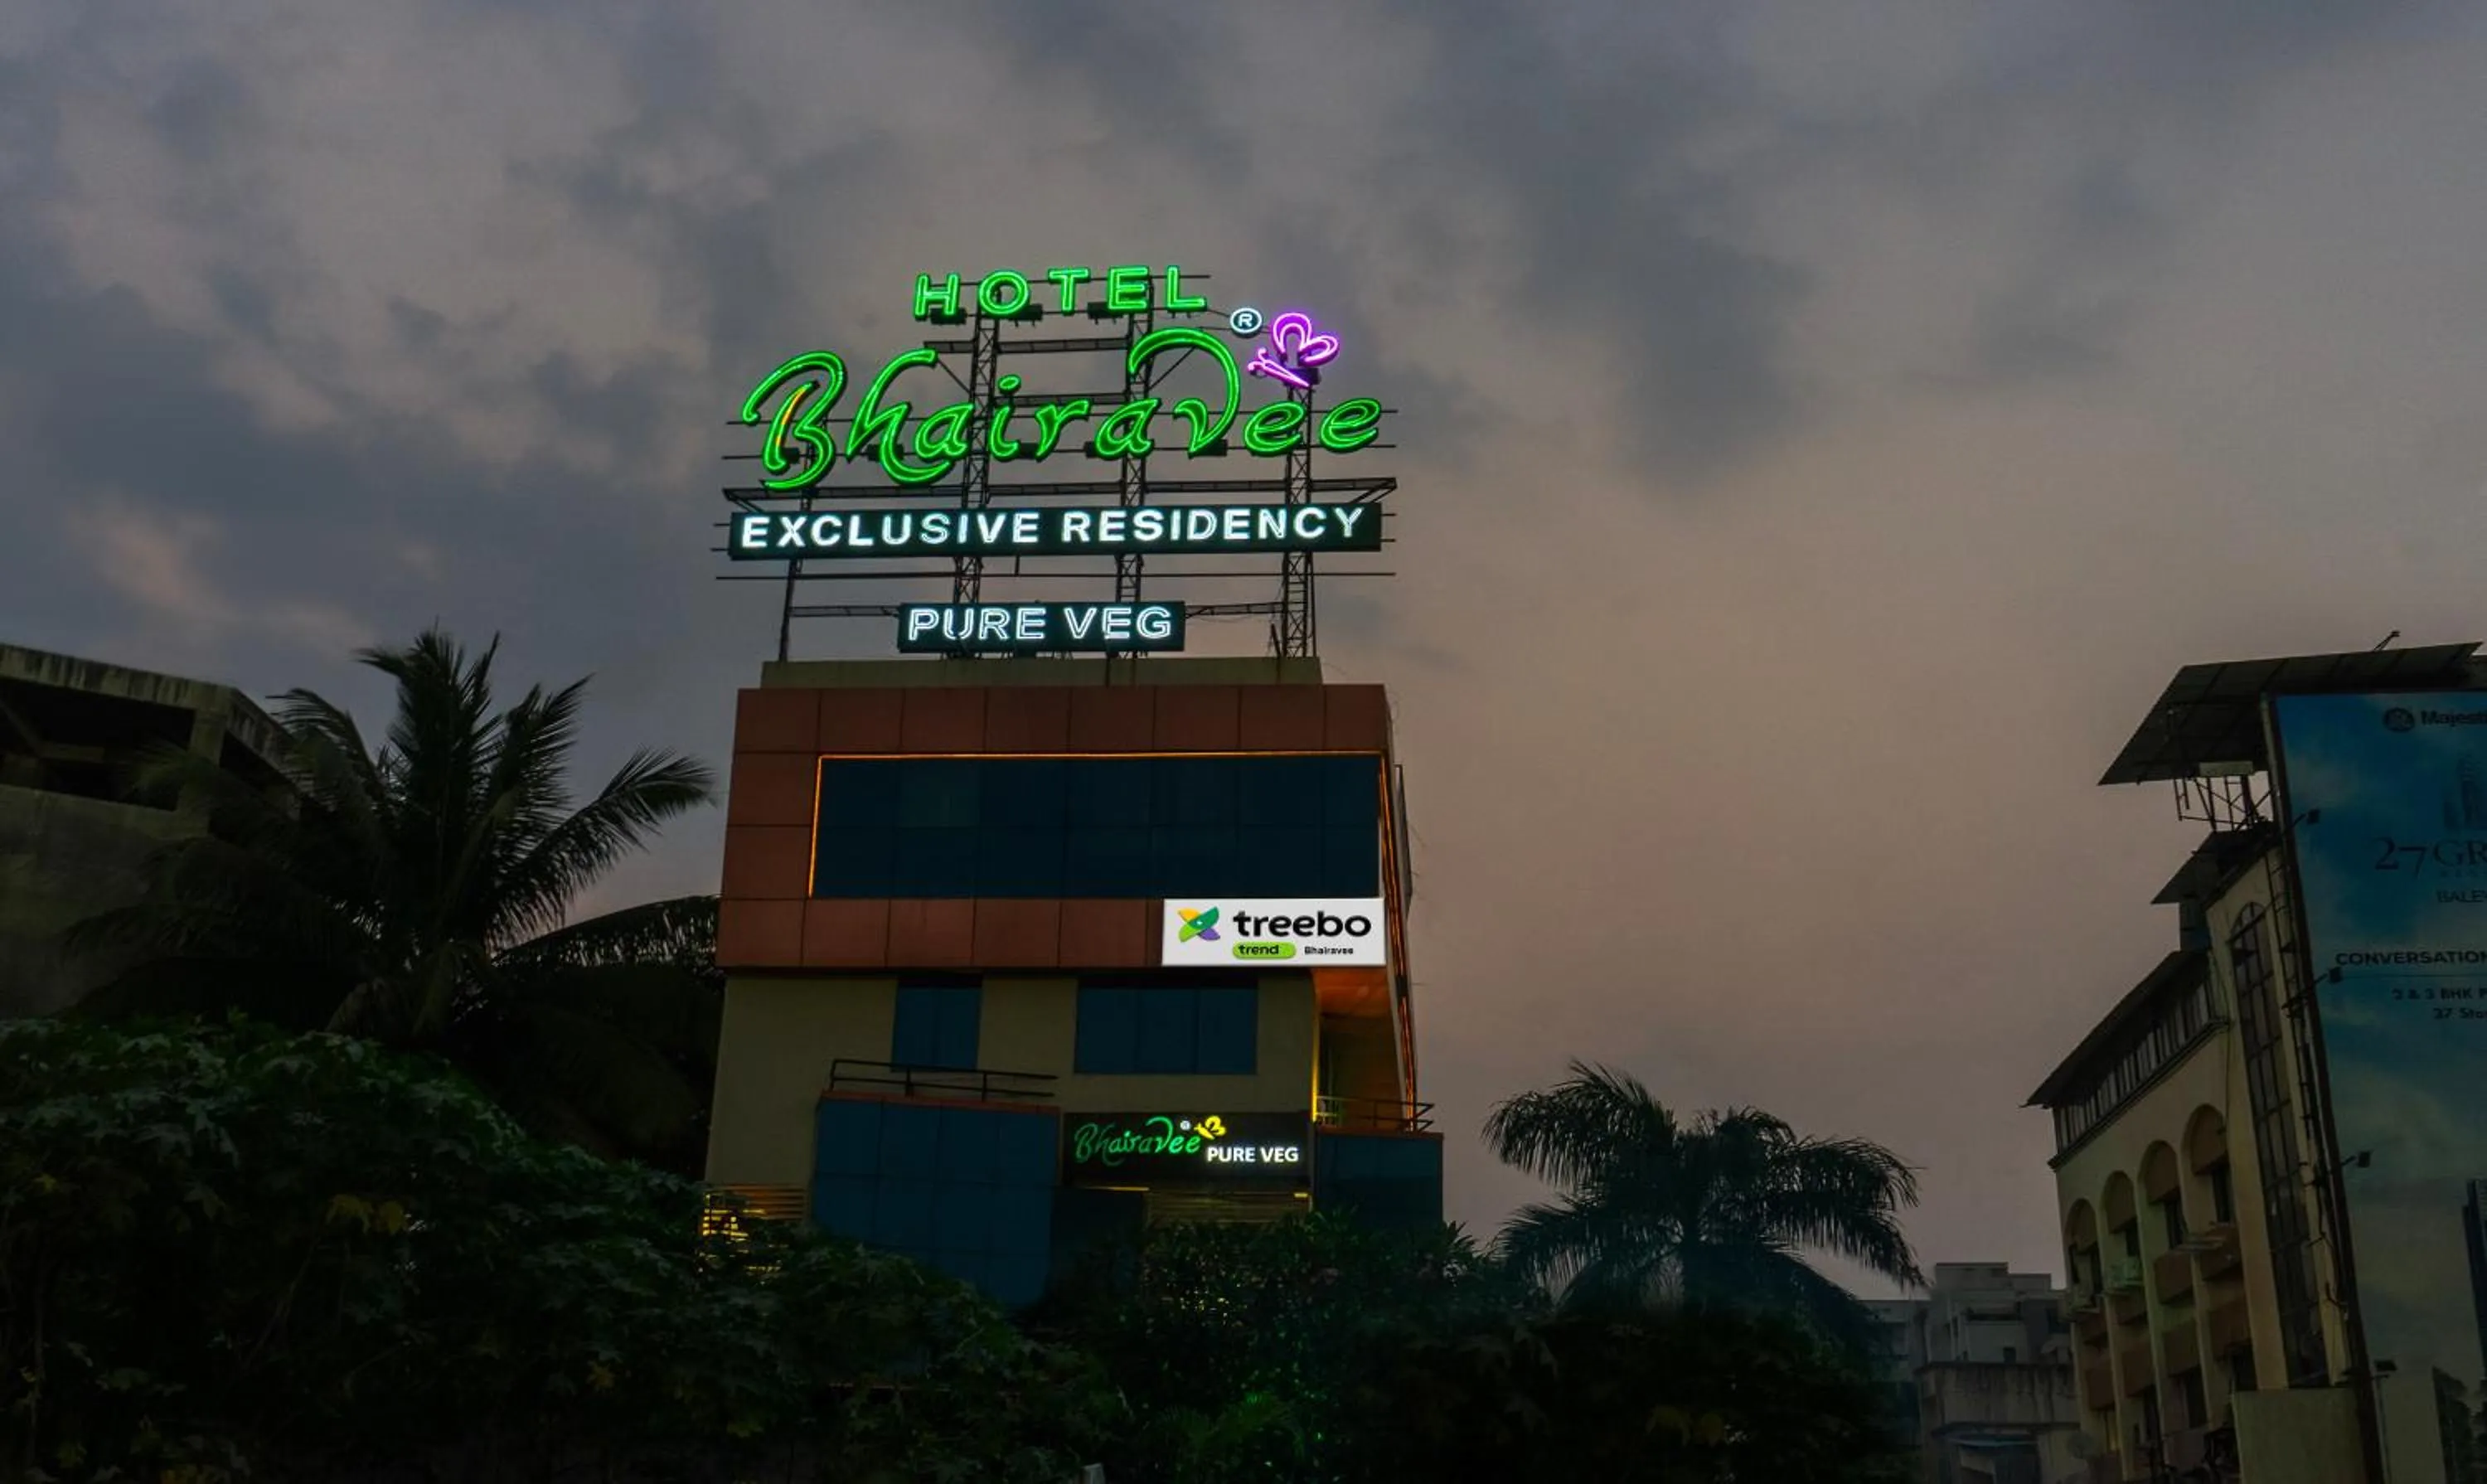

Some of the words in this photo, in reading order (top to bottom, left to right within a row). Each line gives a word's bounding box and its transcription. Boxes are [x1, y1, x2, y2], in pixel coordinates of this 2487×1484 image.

[914, 265, 1208, 318] HOTEL
[742, 327, 1382, 489] Bhairavee
[740, 511, 1040, 549] EXCLUSIVE
[1062, 506, 1365, 543] RESIDENCY
[908, 606, 1046, 641] PURE
[1063, 606, 1174, 640] VEG
[1233, 910, 1372, 937] treebo
[1238, 944, 1279, 954] trend
[1074, 1116, 1200, 1166] Bhairavee
[1207, 1147, 1255, 1162] PURE
[1260, 1147, 1299, 1162] VEG
